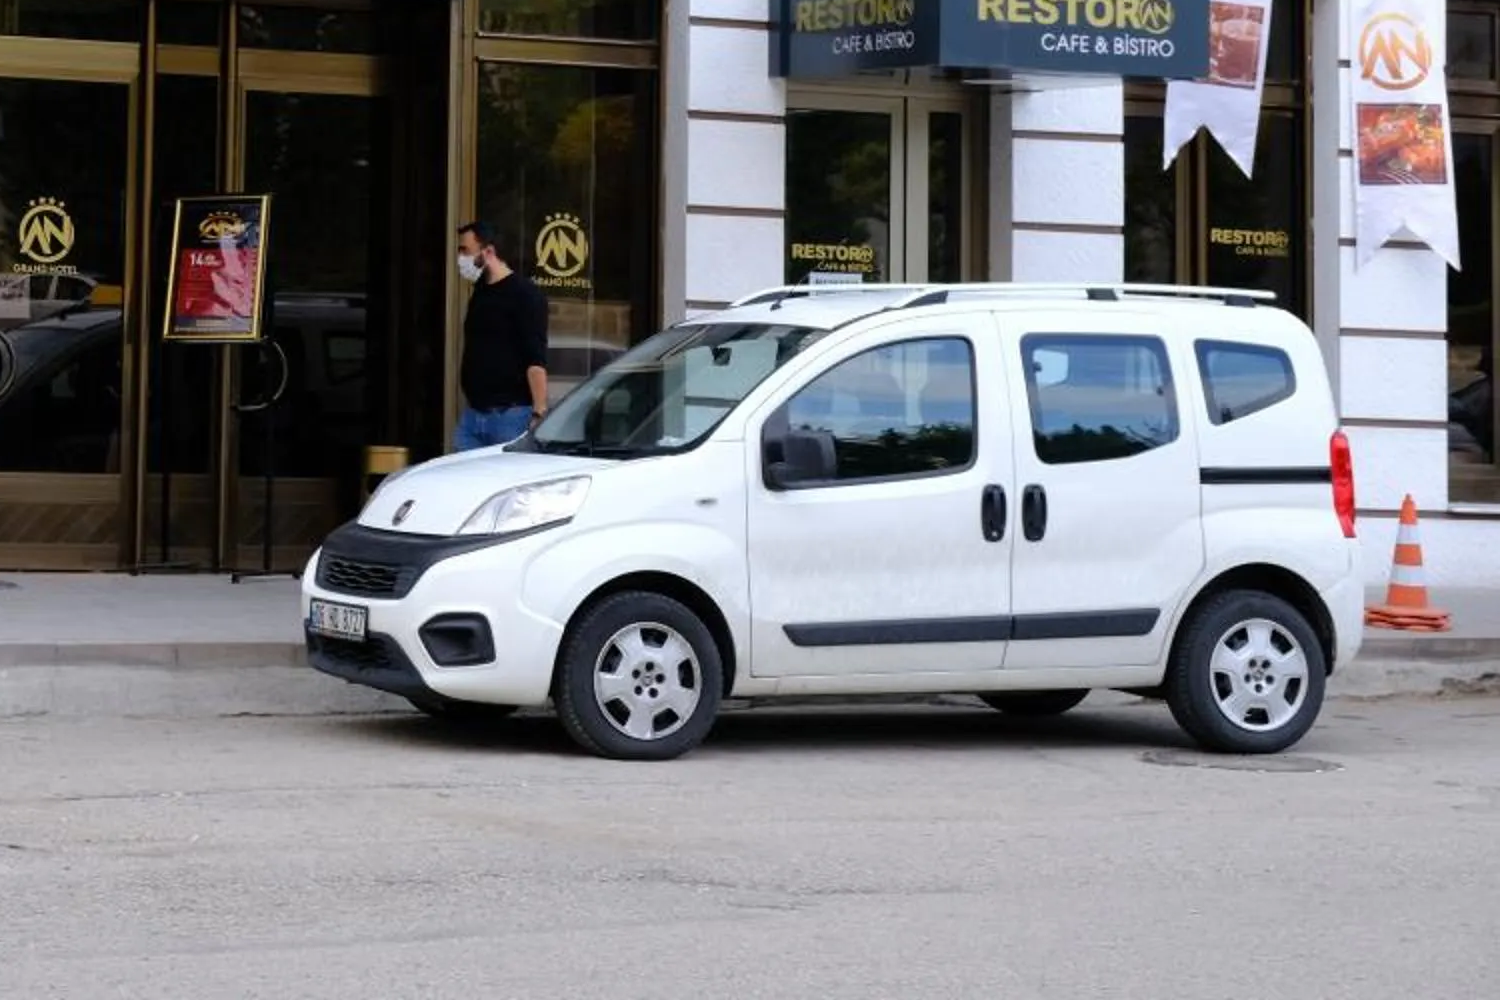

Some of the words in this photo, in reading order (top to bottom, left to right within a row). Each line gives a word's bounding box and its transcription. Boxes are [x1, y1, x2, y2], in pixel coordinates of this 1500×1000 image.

[831, 36, 862, 55] CAFE
[863, 33, 874, 52] &
[1040, 32, 1091, 54] CAFE
[1094, 36, 1109, 55] &
[12, 263, 47, 274] GRAND
[49, 265, 78, 276] HOTEL
